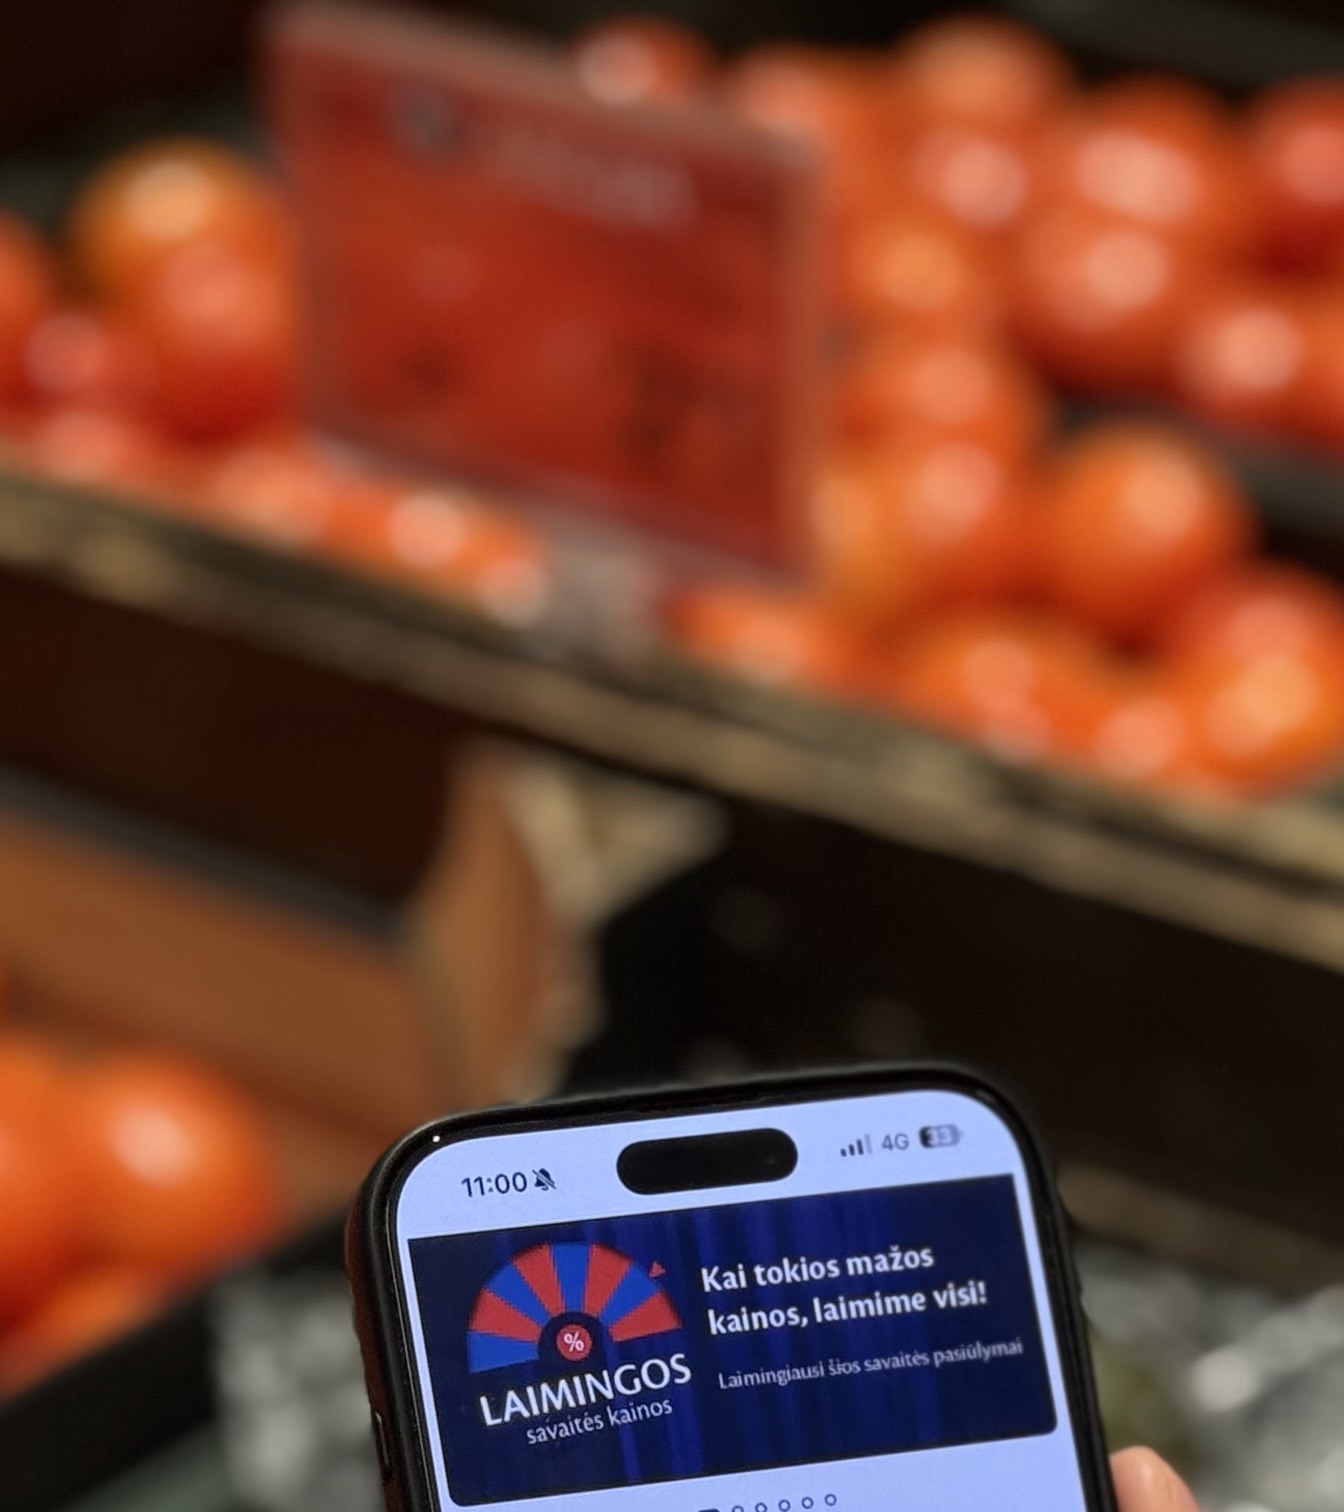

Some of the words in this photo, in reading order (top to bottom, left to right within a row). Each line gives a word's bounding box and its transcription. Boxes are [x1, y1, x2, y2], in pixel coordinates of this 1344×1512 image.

[881, 1132, 910, 1151] 4G
[460, 1171, 528, 1198] 11:00
[701, 1263, 747, 1292] Kai
[754, 1256, 840, 1287] tokios
[846, 1245, 934, 1277] mažos
[708, 1305, 808, 1336] kainos,
[813, 1291, 927, 1324] laimime
[932, 1280, 988, 1309] visi!
[718, 1361, 825, 1390] Laimingiausi
[828, 1358, 862, 1377] šios
[863, 1349, 931, 1373] savaitės
[932, 1336, 1024, 1368] pasiūlymai
[479, 1352, 692, 1427] LAIMINGOS
[526, 1410, 605, 1445] savaitės
[606, 1398, 673, 1427] kainos
